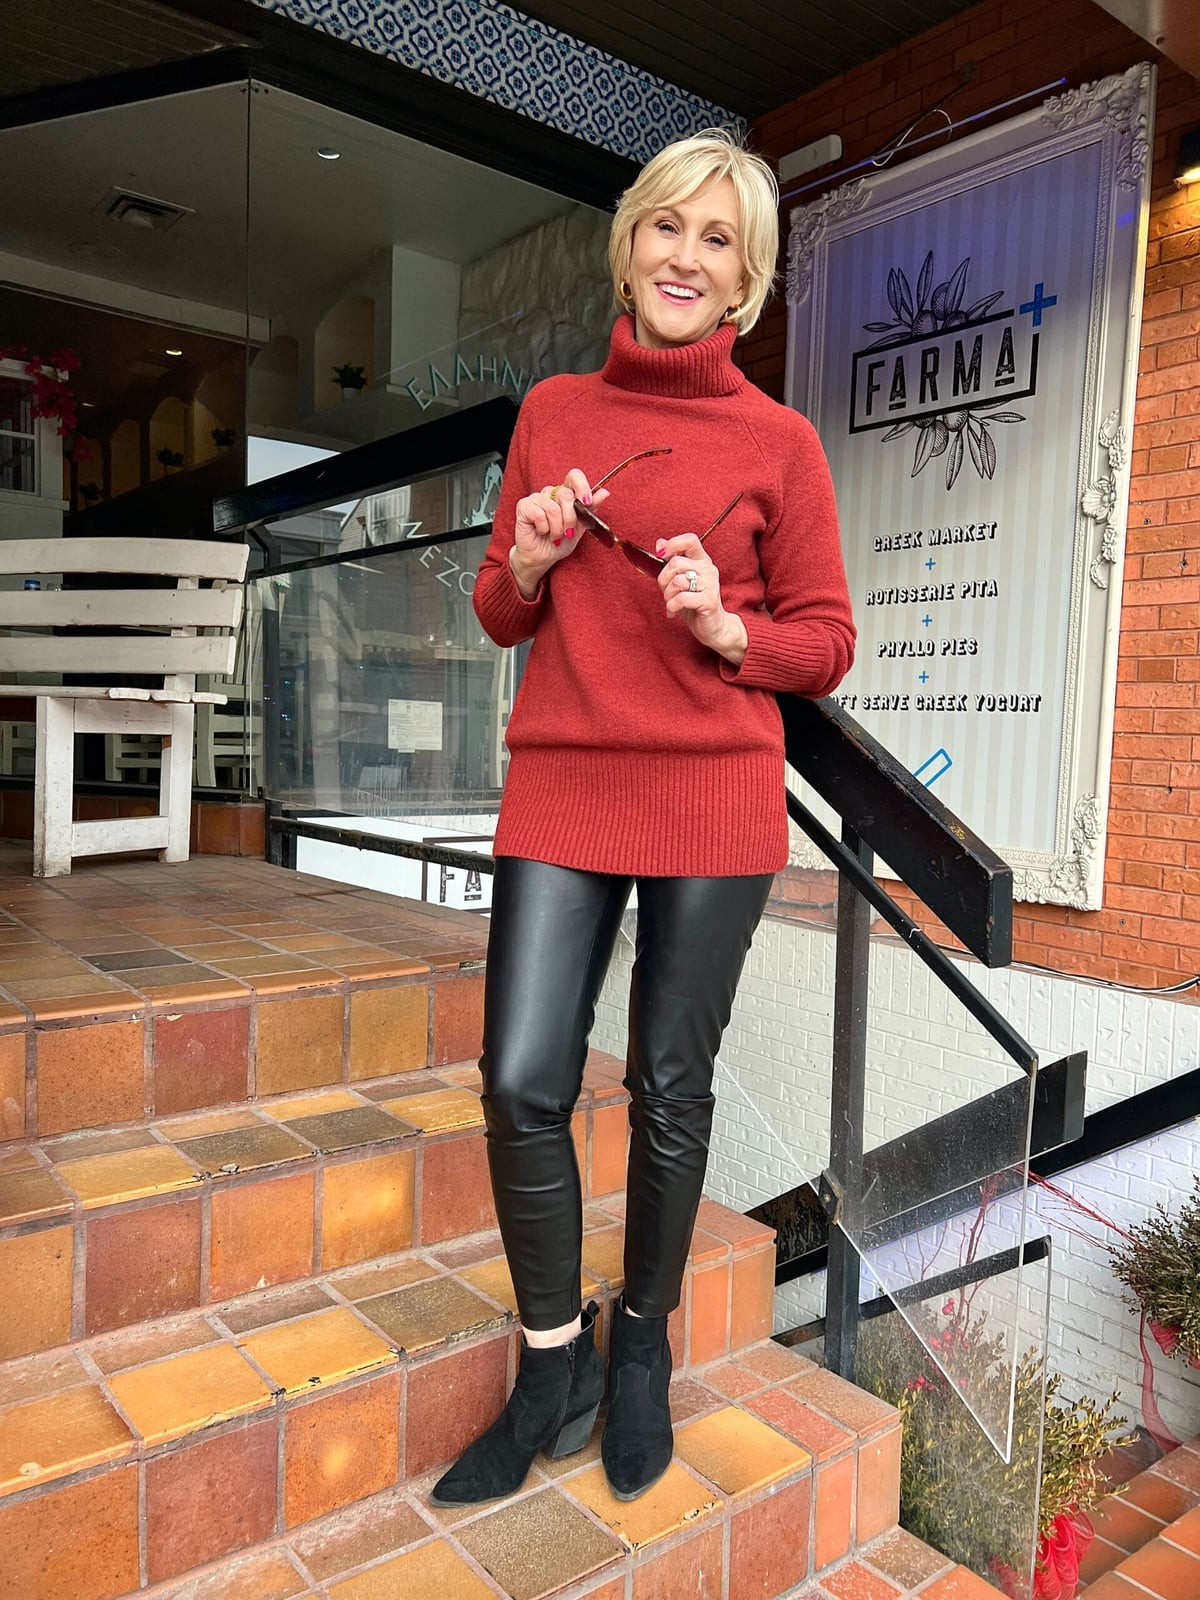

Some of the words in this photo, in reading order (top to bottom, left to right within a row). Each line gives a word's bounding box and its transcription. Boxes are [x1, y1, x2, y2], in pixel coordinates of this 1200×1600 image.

[873, 531, 923, 552] GREEK
[928, 521, 998, 546] MARKET
[865, 583, 954, 605] ROTISSERIE
[960, 579, 998, 599] PITA
[877, 640, 935, 657] PHYLLO
[941, 638, 978, 656] PIES
[862, 694, 910, 710] SERVE
[915, 694, 968, 711] GREEK
[974, 694, 1042, 713] YOGURT
